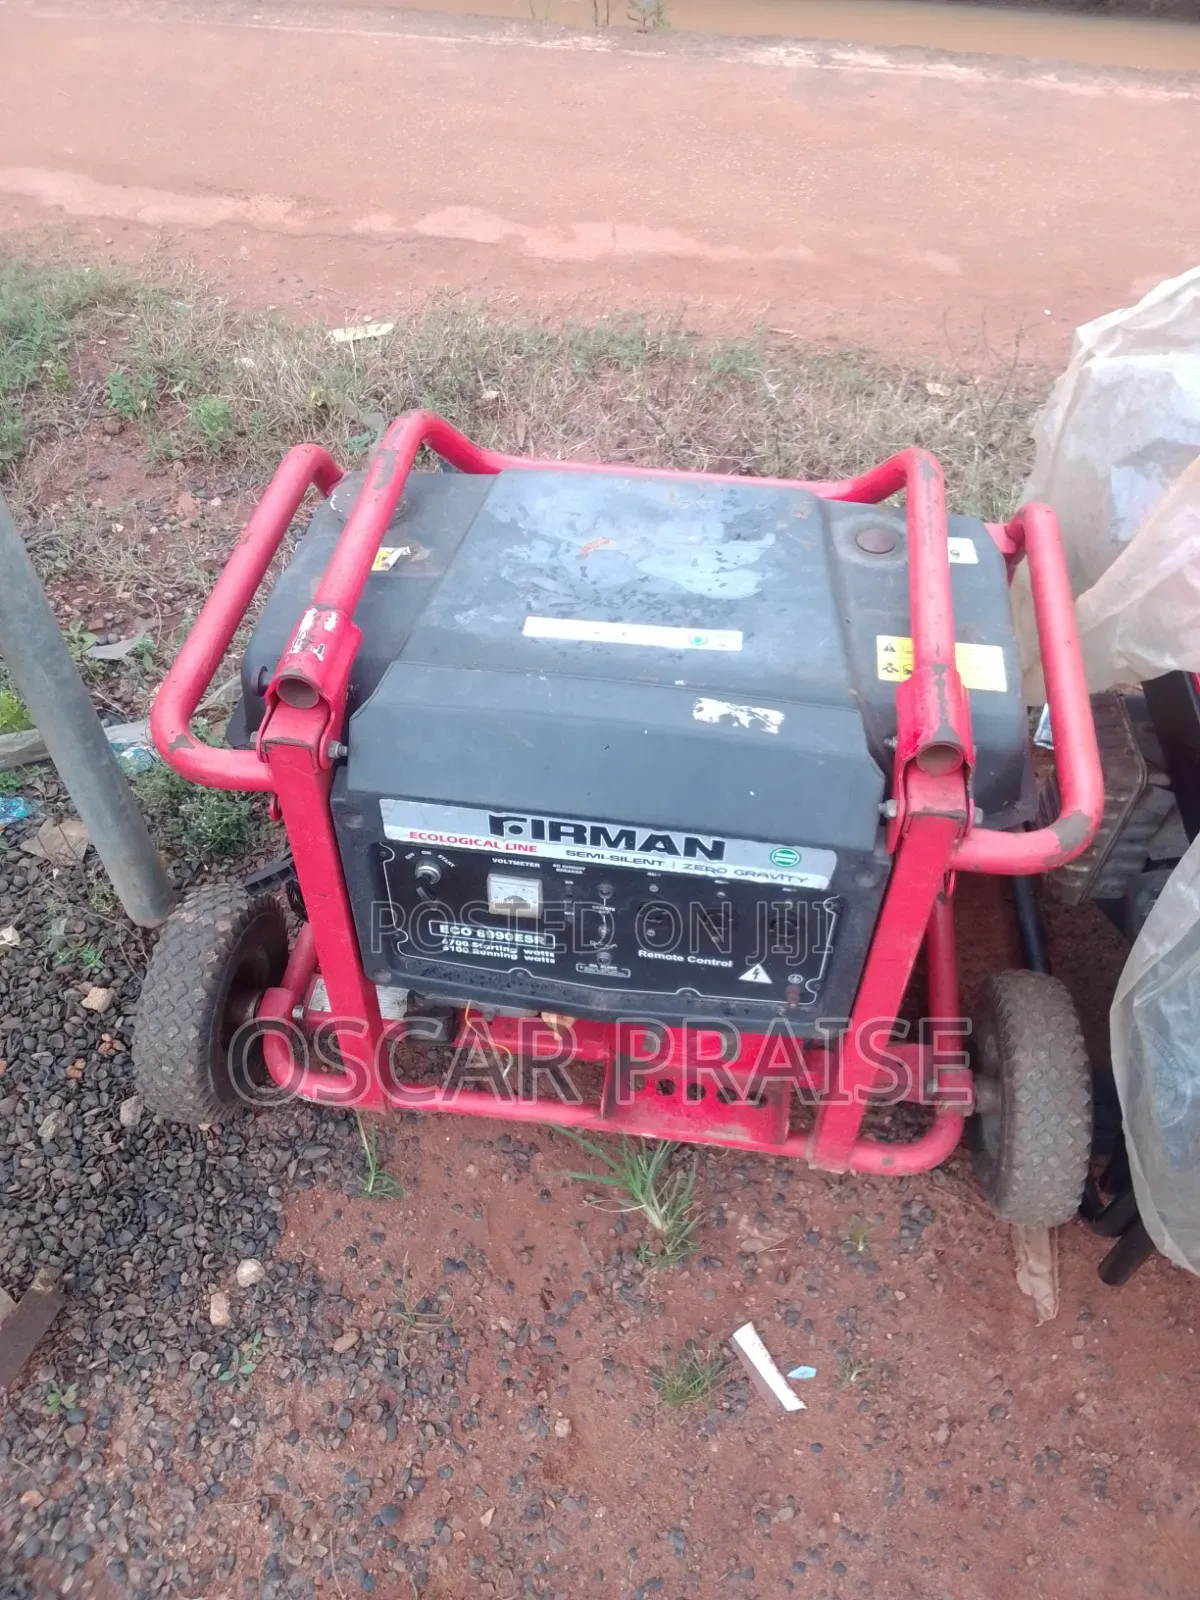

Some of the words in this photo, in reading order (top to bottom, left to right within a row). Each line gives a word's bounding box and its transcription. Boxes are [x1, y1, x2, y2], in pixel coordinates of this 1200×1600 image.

[409, 830, 501, 849] ECOLOGICAL
[505, 843, 538, 853] LINE
[488, 813, 726, 861] FIRMAN
[437, 854, 456, 868] START
[492, 857, 541, 868] VOLTMETER
[565, 849, 665, 867] SEMI-SILENT
[682, 863, 728, 875] ZERO
[733, 869, 809, 883] GRAVITY
[439, 924, 472, 937] ECO
[471, 942, 518, 954] Starting
[523, 949, 555, 958] watts
[472, 949, 518, 960] Running
[524, 955, 556, 964] watts
[637, 949, 685, 963] Remote
[687, 955, 734, 968] Control
